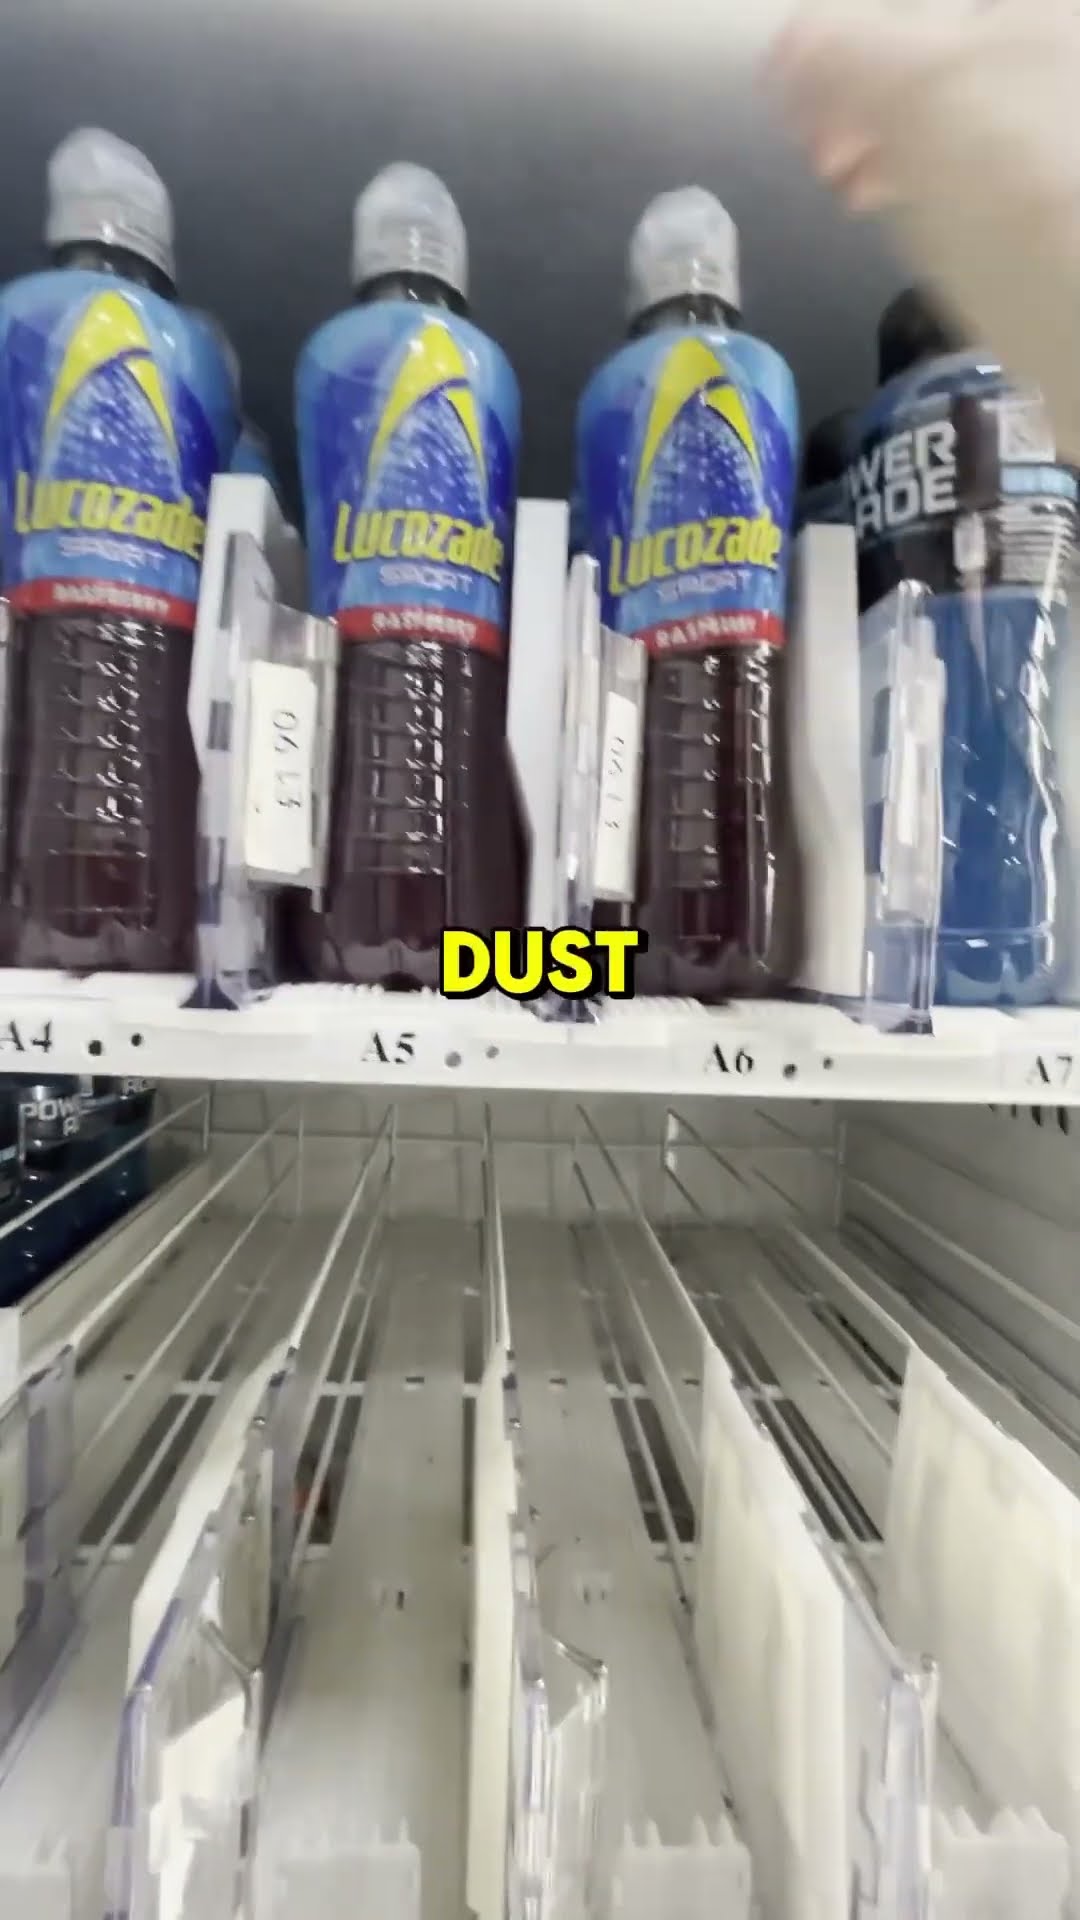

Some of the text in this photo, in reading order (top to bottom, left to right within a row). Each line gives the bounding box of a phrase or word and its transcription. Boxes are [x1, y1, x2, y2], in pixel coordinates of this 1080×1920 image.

[15, 469, 205, 560] Lucozade
[855, 466, 957, 540] ADE
[333, 499, 504, 583] Lucozade
[609, 507, 782, 597] Lucozade
[0, 1020, 52, 1053] A4
[361, 1031, 416, 1064] A5
[703, 1042, 755, 1074] A6
[1026, 1055, 1073, 1087] A7
